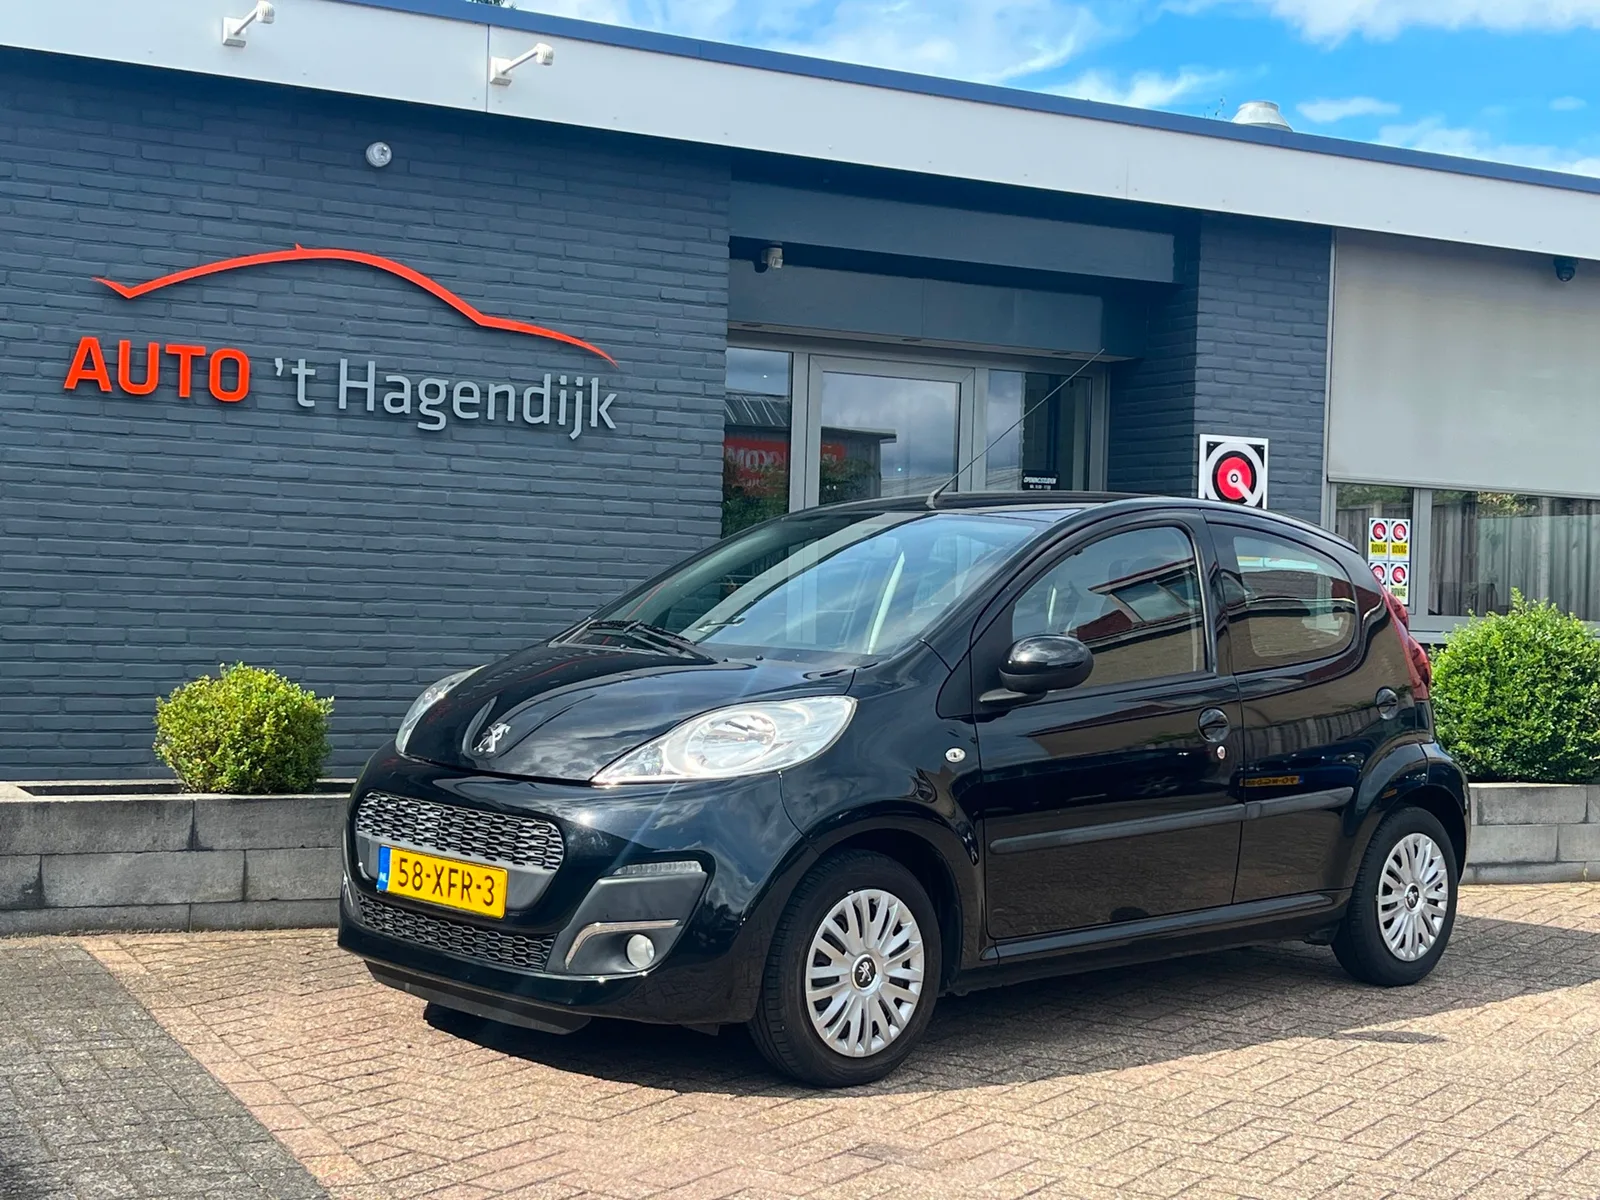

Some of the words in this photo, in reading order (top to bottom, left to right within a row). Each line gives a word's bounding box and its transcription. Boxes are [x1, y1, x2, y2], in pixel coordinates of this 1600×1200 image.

[64, 336, 249, 402] AUTO
[338, 358, 618, 440] Hagendijk
[398, 858, 495, 906] 58-XFR-3
